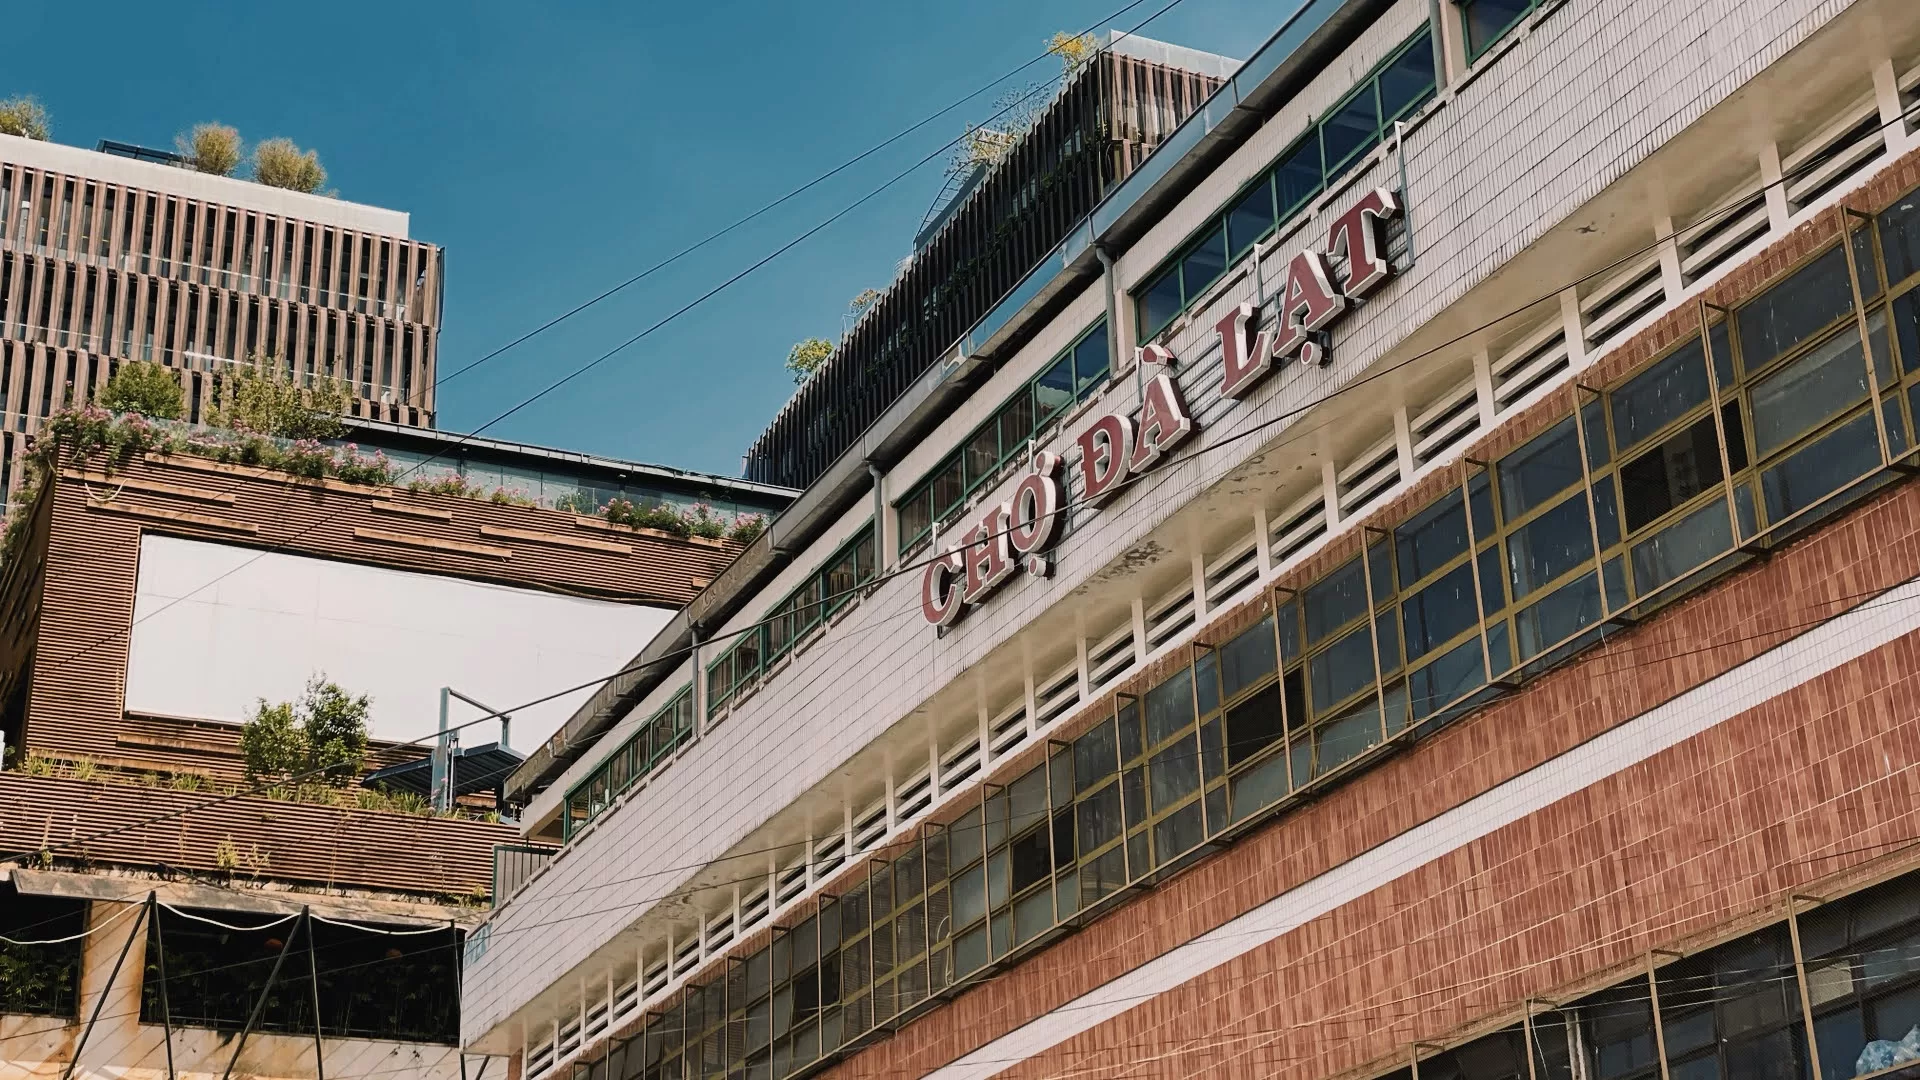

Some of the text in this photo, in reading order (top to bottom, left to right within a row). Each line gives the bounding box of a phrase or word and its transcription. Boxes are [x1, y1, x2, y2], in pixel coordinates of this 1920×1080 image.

[922, 186, 1399, 627] CHỢ ĐÀ LẠT
